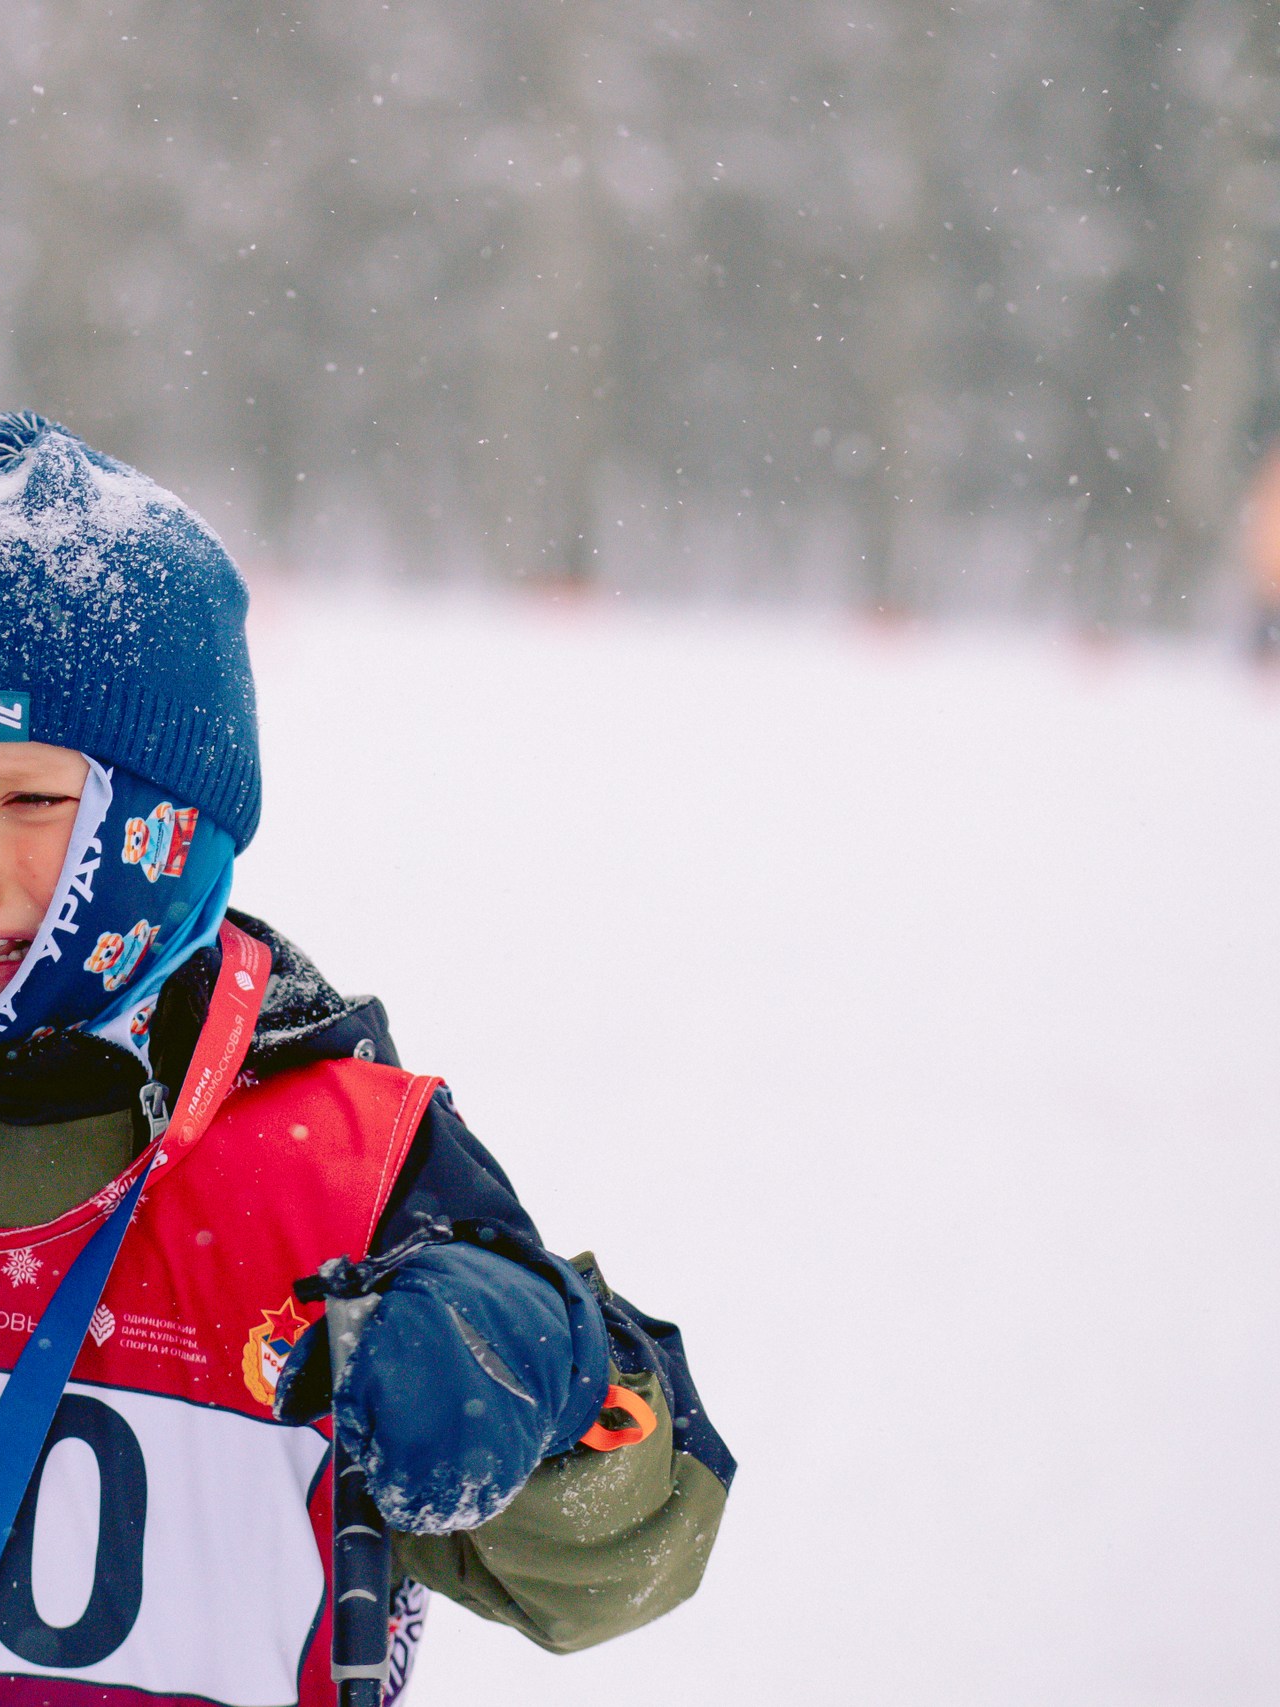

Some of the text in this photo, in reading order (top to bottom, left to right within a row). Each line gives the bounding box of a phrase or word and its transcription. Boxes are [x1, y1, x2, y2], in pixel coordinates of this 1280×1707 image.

[187, 1066, 213, 1116] ПАРКИ
[193, 1014, 246, 1123] ПОДМОСКОВЬЯ
[120, 1338, 159, 1353] СПОРТА
